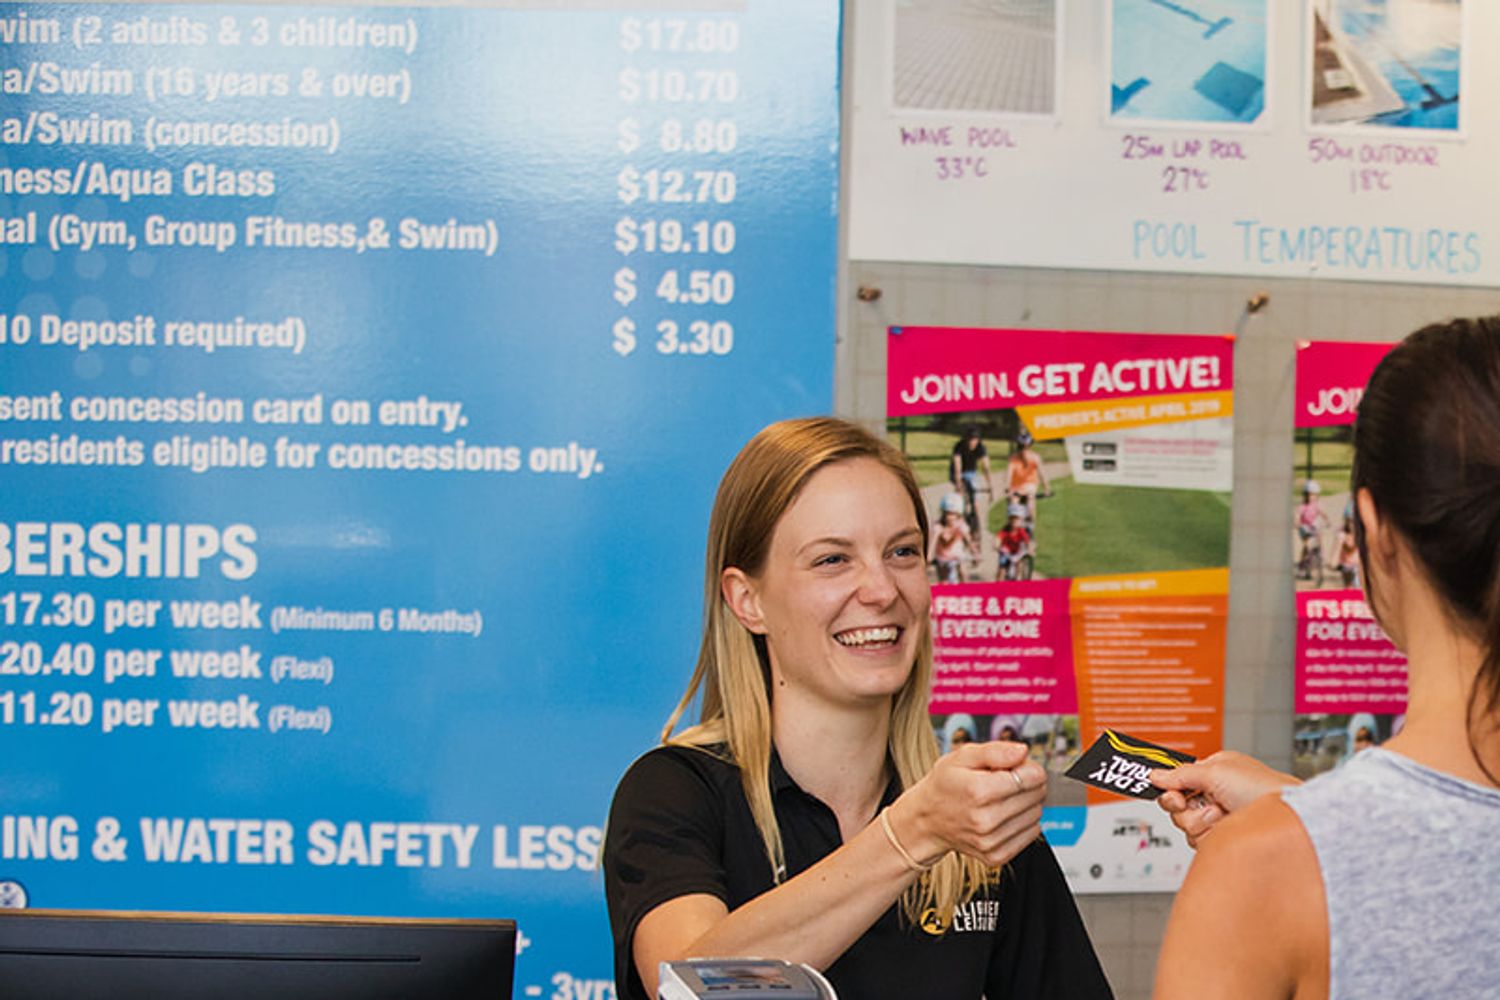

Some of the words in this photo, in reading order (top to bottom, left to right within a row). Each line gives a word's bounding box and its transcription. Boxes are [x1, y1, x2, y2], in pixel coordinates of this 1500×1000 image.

[72, 16, 102, 50] (2
[111, 16, 208, 46] adults
[218, 19, 241, 46] &
[250, 18, 270, 46] 3
[279, 18, 418, 54] children)
[619, 17, 738, 54] $17.80
[0, 61, 133, 95] a/Swim
[145, 66, 194, 103] (16
[205, 71, 289, 102] years
[299, 68, 322, 98] &
[333, 68, 411, 104] over)
[618, 67, 738, 103] $10.70
[144, 117, 341, 154] (concession)
[900, 126, 953, 147] WAVE
[968, 128, 1018, 148] POOL
[1172, 139, 1202, 159] LAP
[1210, 138, 1247, 160] POOL
[1360, 144, 1440, 168] OUTDOOR
[183, 163, 275, 196] Class
[617, 165, 736, 205] $12.70
[48, 214, 137, 253] (Gym,
[145, 215, 237, 253] Group
[399, 219, 498, 256] Swim)
[614, 217, 736, 256] $19.10
[1132, 219, 1207, 259] POOL
[1233, 220, 1481, 274] TEMPERATURES
[40, 315, 156, 351] Deposit
[163, 317, 306, 354] required)
[900, 374, 973, 405] JOIN
[978, 372, 1015, 400] IN.
[1018, 363, 1085, 398] GET
[1089, 356, 1222, 394] ACTIVE!
[71, 392, 244, 425] concession
[252, 394, 324, 425] card
[331, 402, 370, 425] on
[379, 395, 469, 433] entry.
[2, 433, 145, 466] residents
[153, 435, 266, 472] eligible
[274, 437, 321, 469] for
[328, 439, 521, 472] concessions
[529, 441, 604, 479] only.
[2, 592, 95, 628] 17.30
[104, 599, 161, 633] per
[171, 596, 261, 631] week
[270, 605, 374, 633] (Minimum
[379, 608, 393, 631] 6
[398, 607, 483, 637] Months)
[936, 596, 983, 616] FREE
[1004, 597, 1043, 616] FUN
[1306, 599, 1340, 619] IT'S
[941, 619, 1041, 639] EVERYONE
[1306, 621, 1344, 640] FOR
[0, 642, 95, 676] 20.40
[104, 648, 161, 683] per
[171, 645, 261, 679] week
[270, 656, 333, 685] (Flexi)
[3, 691, 93, 725] 11.20
[102, 697, 160, 733] per
[169, 695, 260, 728] week
[268, 705, 331, 734] (Flexi)
[2, 815, 79, 860] ING
[92, 816, 128, 862] &
[141, 817, 294, 865] WATER
[306, 820, 480, 869] SAFETY
[492, 825, 603, 870] LESS
